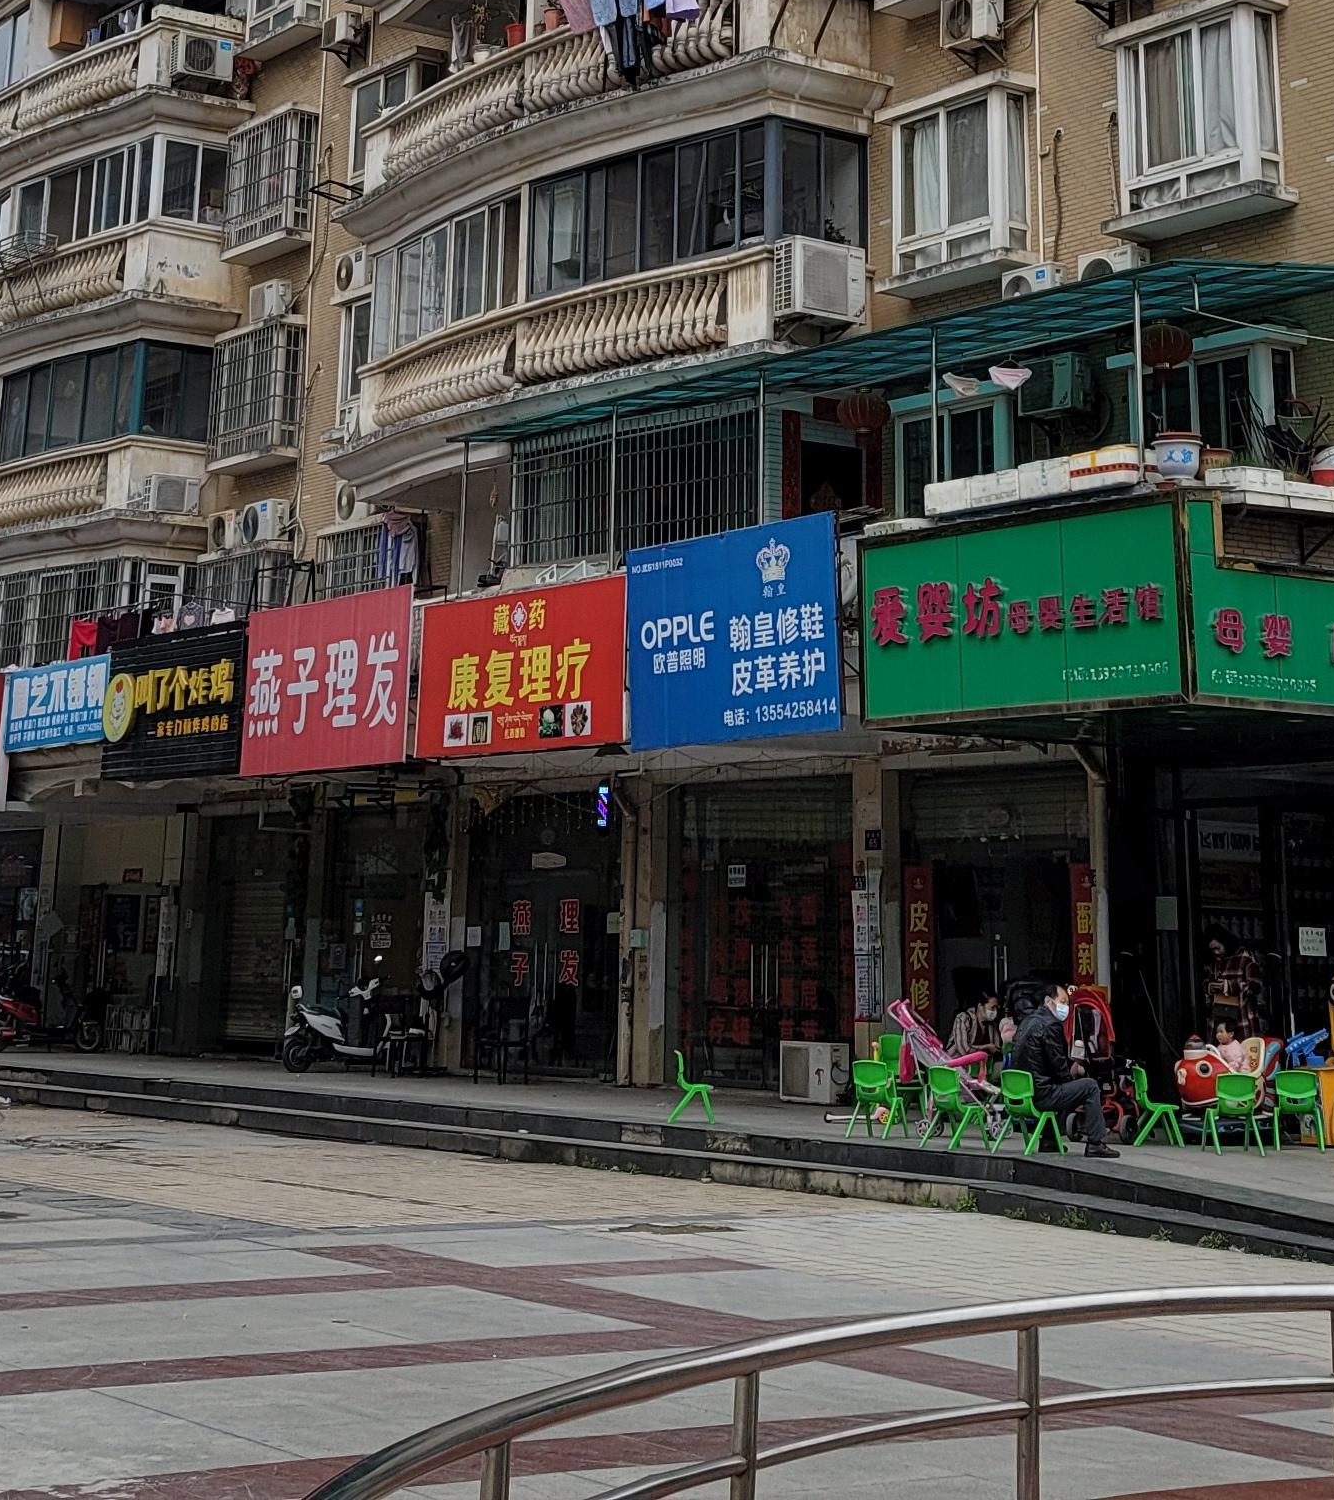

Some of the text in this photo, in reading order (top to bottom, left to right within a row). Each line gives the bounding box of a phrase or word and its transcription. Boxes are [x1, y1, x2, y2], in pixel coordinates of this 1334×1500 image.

[762, 582, 787, 599] 翰皇
[871, 577, 1163, 646] 爱婴坊 母婴生活馆
[492, 598, 547, 636] 藏药
[640, 610, 715, 650] OPPLE
[729, 602, 825, 652] 翰皇修鞋
[248, 630, 399, 738] 燕子理发
[447, 638, 591, 711] 康复理疗
[653, 647, 706, 674] 欧普照明
[731, 648, 826, 697] 皮革养护
[133, 658, 236, 715] 叫了个炸鸡
[755, 697, 837, 723] 13554258414
[510, 900, 531, 987] 燕子
[558, 898, 579, 988] 理发
